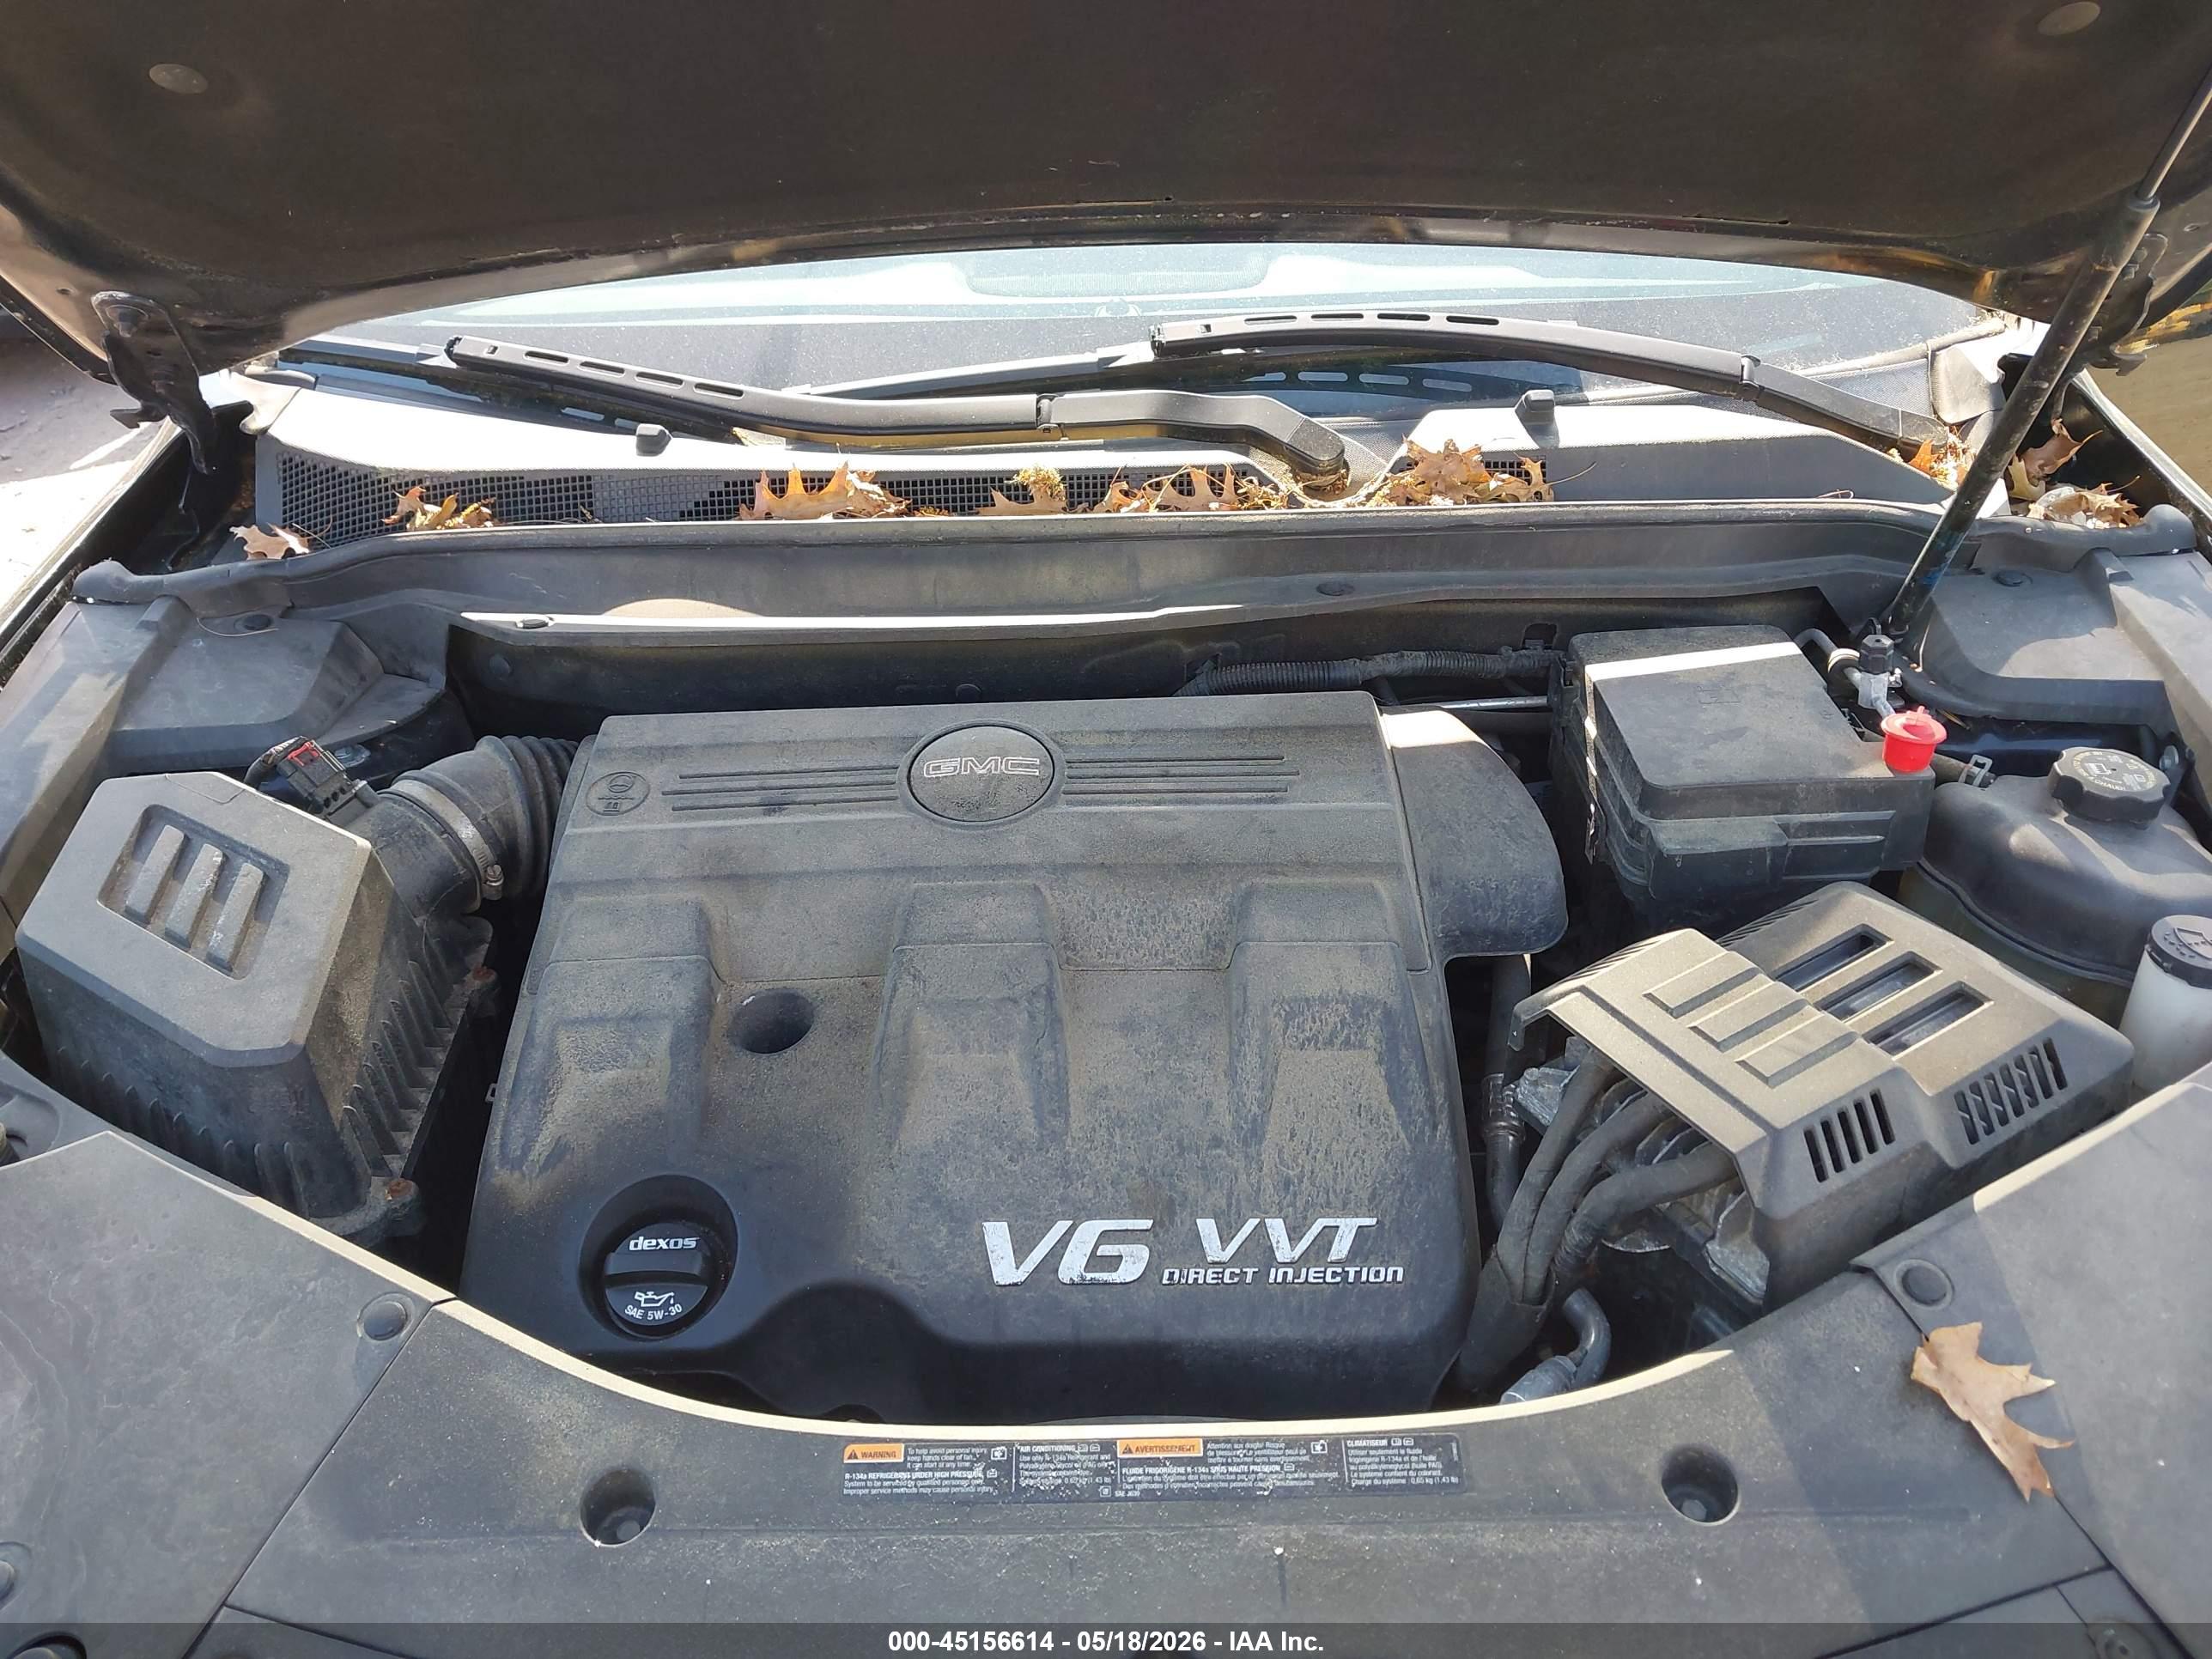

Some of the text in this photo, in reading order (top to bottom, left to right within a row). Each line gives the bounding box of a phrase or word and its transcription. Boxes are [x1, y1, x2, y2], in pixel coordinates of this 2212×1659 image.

[924, 757, 1039, 777] GMC
[629, 1236, 700, 1251] dexos
[1196, 1218, 1377, 1263] VVT
[981, 1219, 1154, 1285] V6
[1162, 1267, 1404, 1285] DIRECT INJECTION
[624, 1304, 683, 1320] SAE 5W-30
